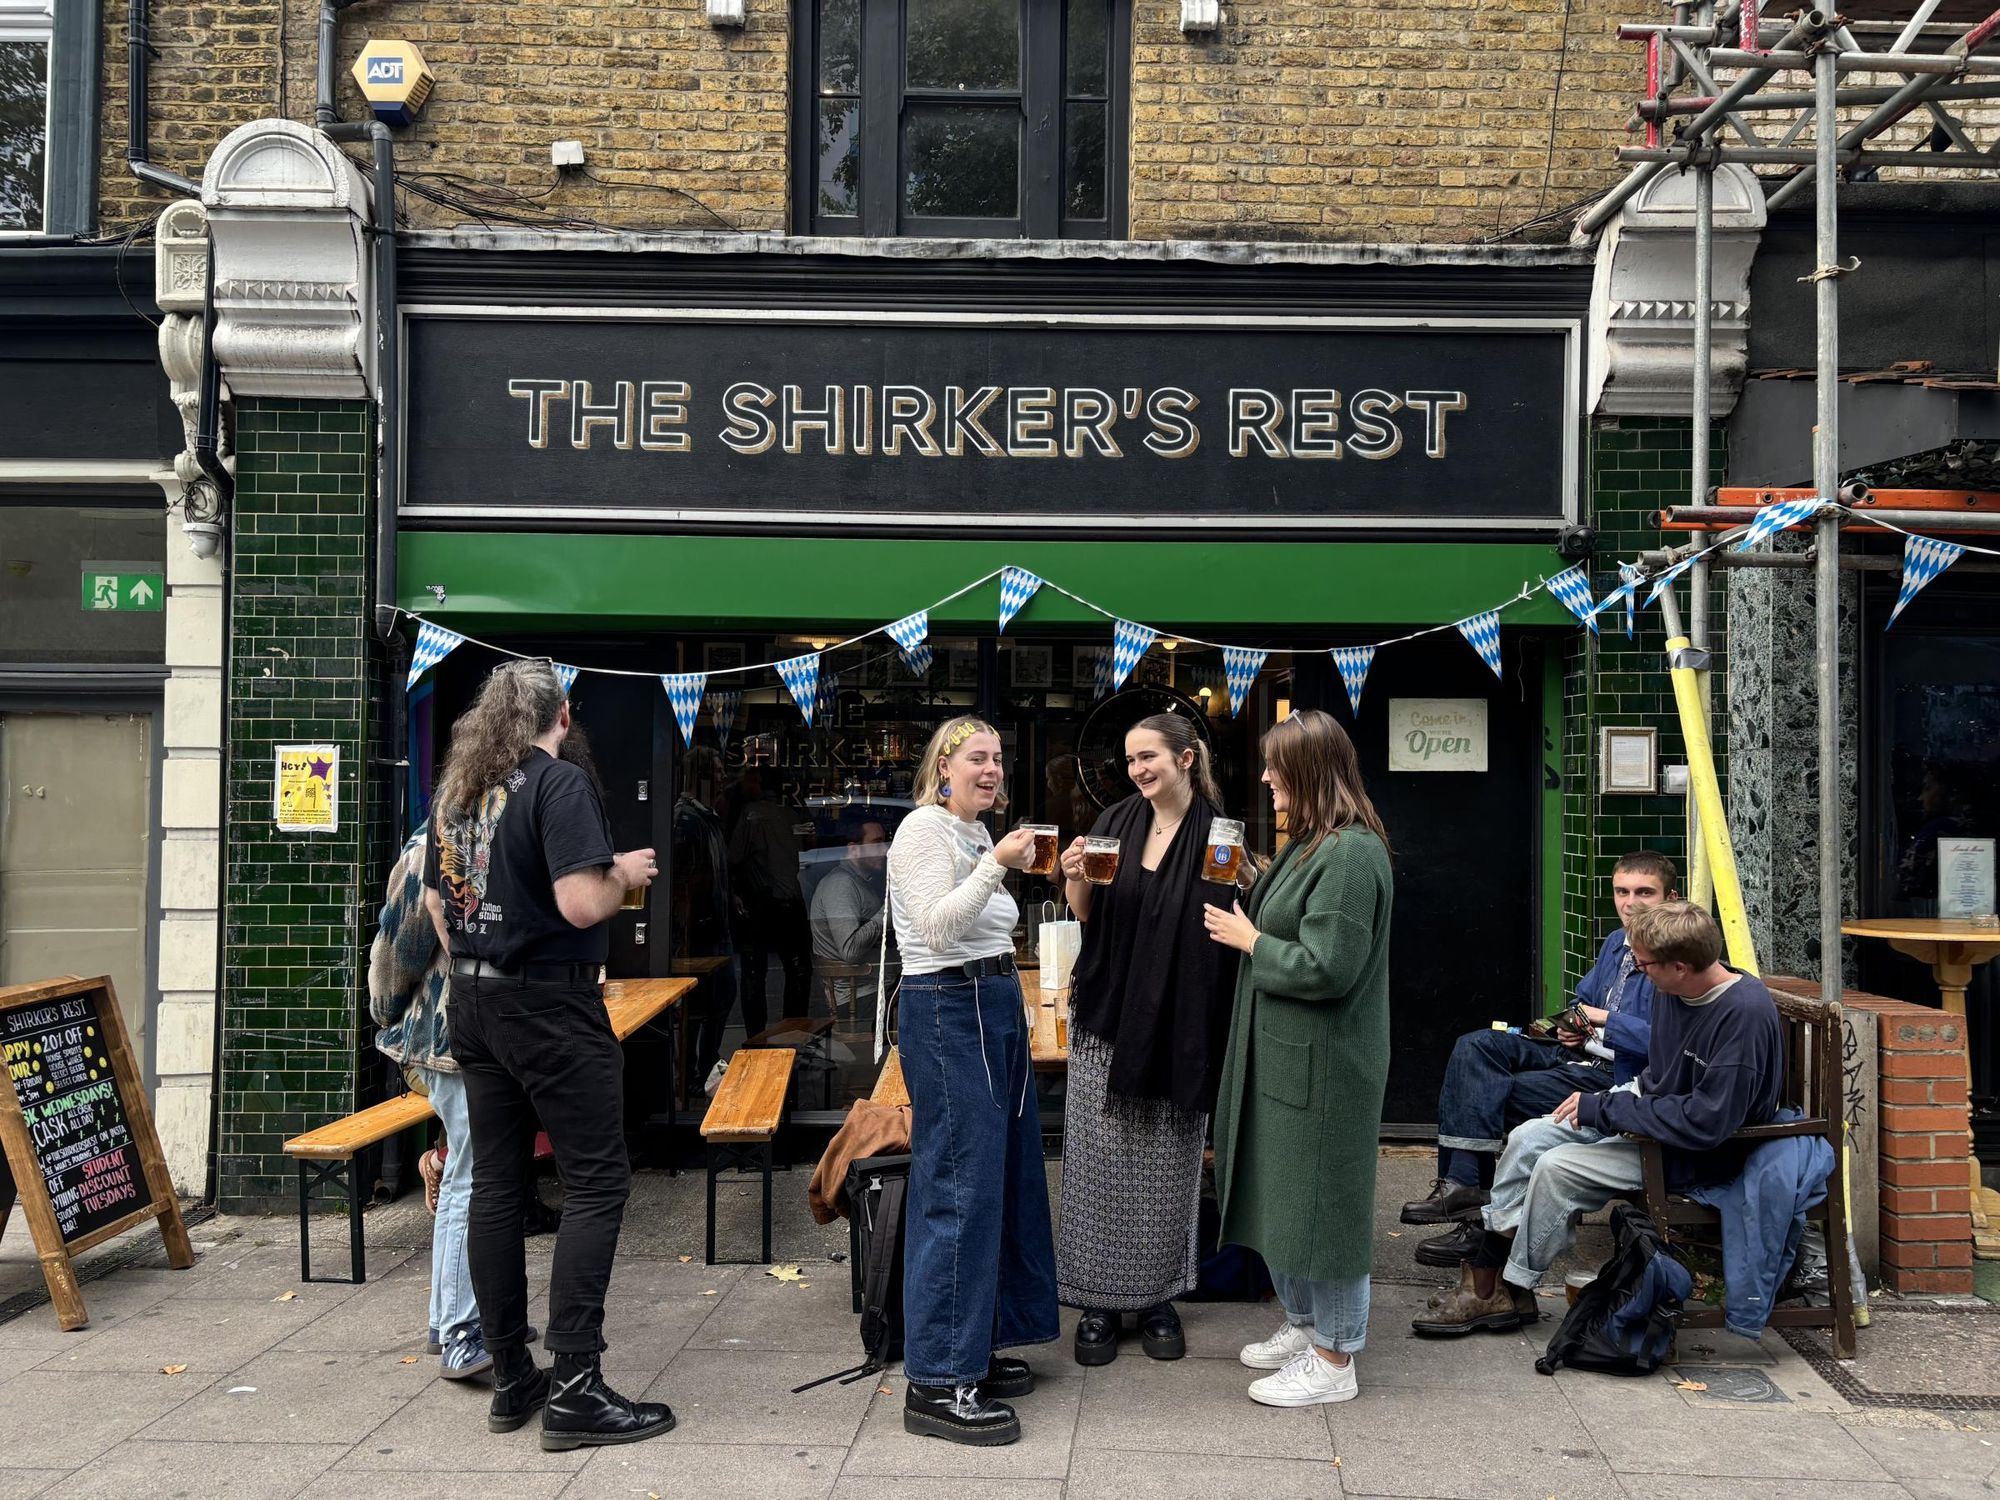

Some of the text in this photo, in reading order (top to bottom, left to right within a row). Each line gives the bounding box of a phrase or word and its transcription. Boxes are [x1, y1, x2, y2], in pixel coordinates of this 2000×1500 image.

[367, 62, 404, 79] ADT
[508, 379, 1467, 460] THE SHIRKER'S REST
[1405, 730, 1472, 761] Open
[478, 911, 503, 922] studio
[481, 901, 502, 913] tattoo
[7, 998, 87, 1033] SHIRKER'S REST
[64, 1026, 83, 1045] OFF
[2, 1040, 30, 1061] PPY
[8, 1061, 33, 1081] OUR
[51, 1068, 69, 1081] SELECT
[54, 1076, 72, 1090] SELECT
[22, 1081, 115, 1128] SK WEDNESDAYS!
[67, 1103, 94, 1119] ALL CASK
[32, 1114, 70, 1148] CASK
[69, 1111, 95, 1131] ALL DAY
[99, 1130, 109, 1141] ON
[109, 1124, 127, 1138] INSTA
[44, 1166, 54, 1176] SEE
[82, 1149, 126, 1180] STUDENT
[48, 1174, 64, 1194] OFF
[78, 1164, 132, 1198] DISCOUNT
[82, 1182, 137, 1214] TUESDAYS
[56, 1202, 81, 1223] STUDENT
[61, 1217, 79, 1235] BAR!
